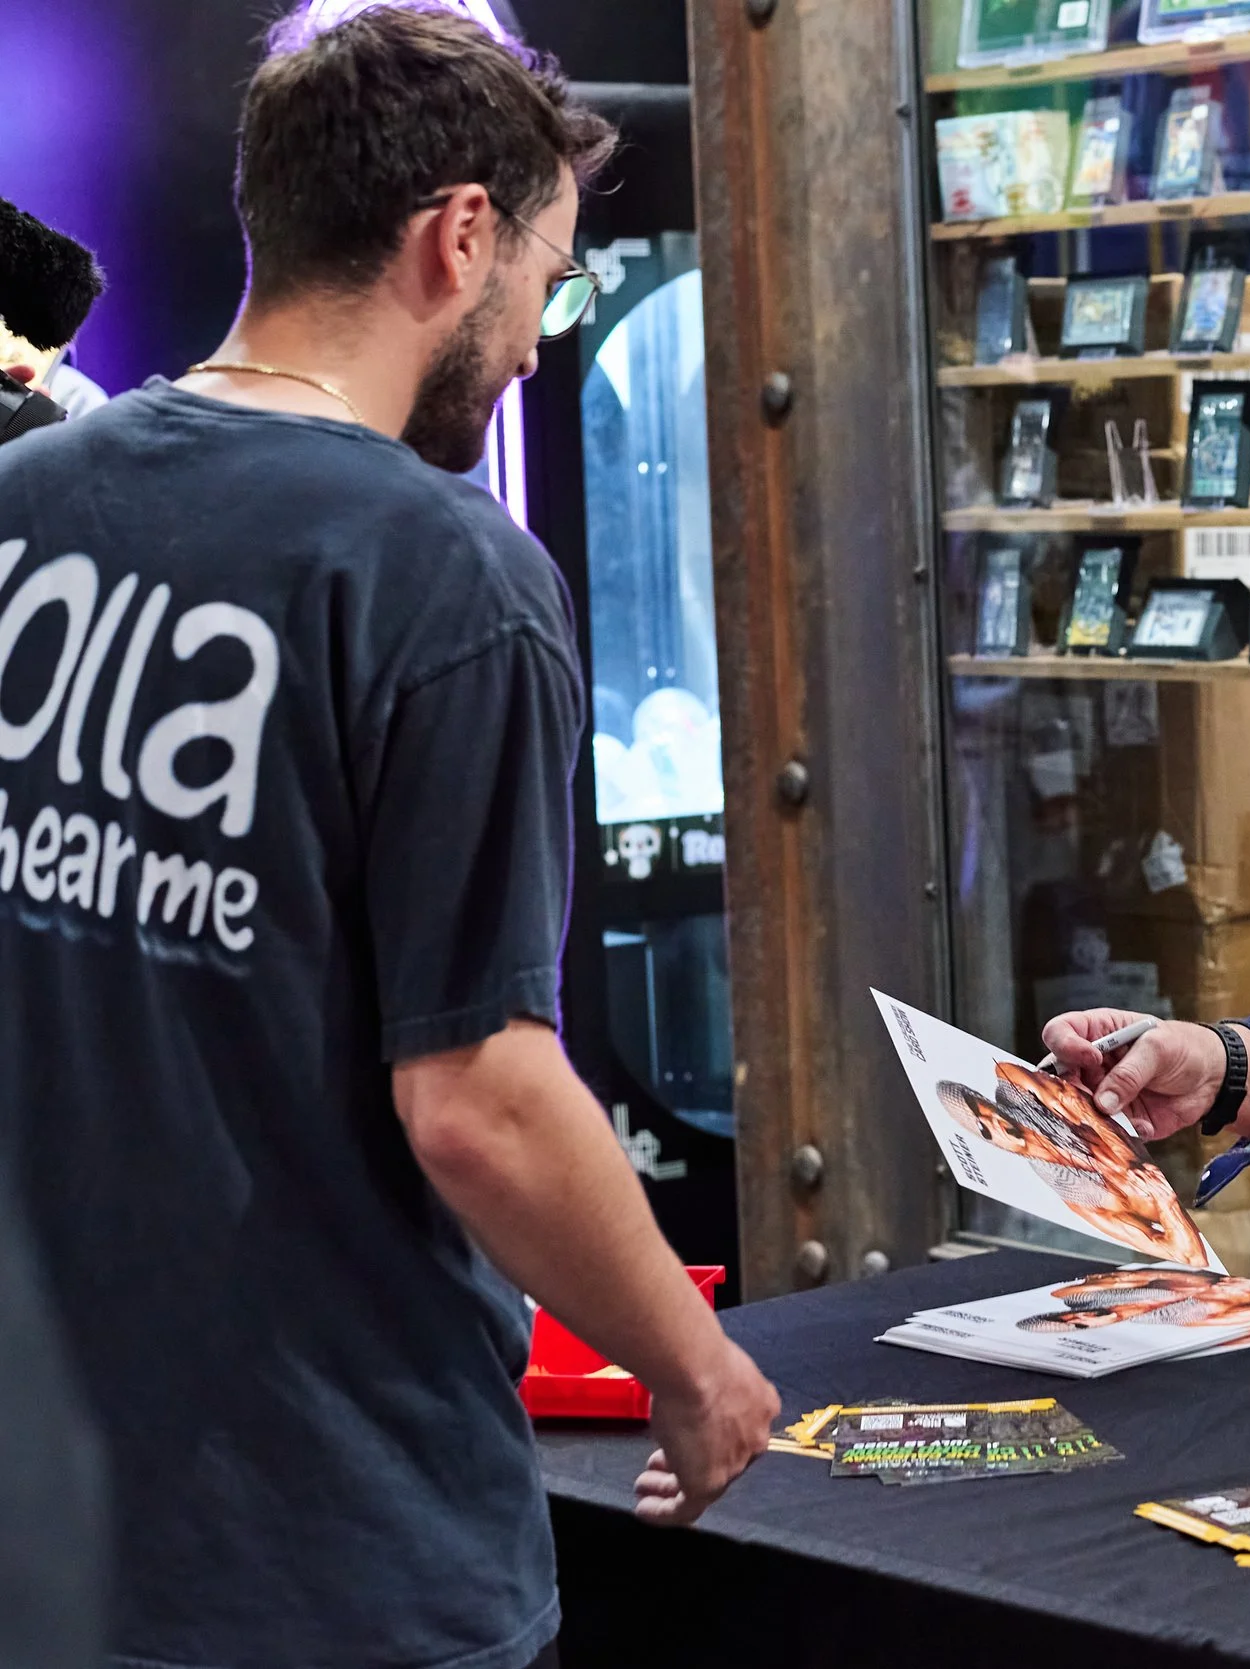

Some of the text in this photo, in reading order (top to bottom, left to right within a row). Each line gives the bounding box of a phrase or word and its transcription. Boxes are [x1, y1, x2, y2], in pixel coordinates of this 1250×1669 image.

[0, 538, 279, 837] olla
[137, 851, 258, 951] me
[949, 1139, 977, 1184] SCOTT
[954, 1132, 989, 1188] STEINER
